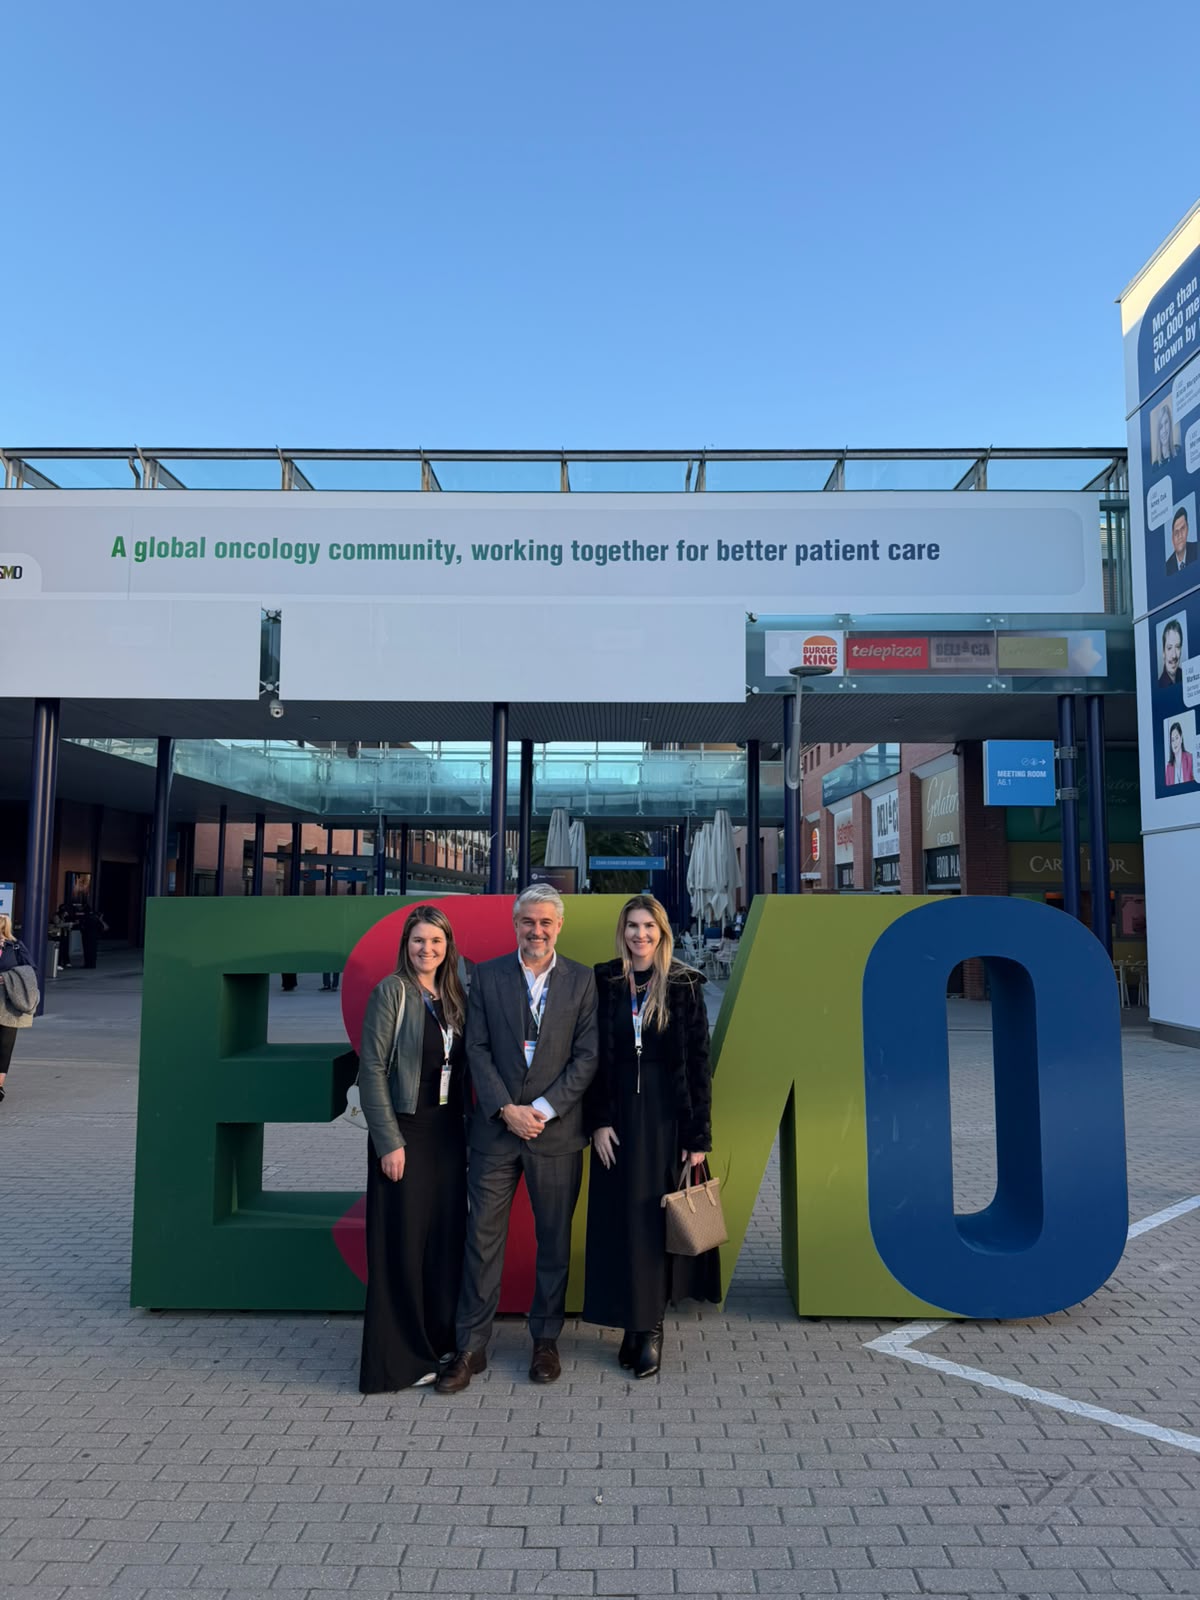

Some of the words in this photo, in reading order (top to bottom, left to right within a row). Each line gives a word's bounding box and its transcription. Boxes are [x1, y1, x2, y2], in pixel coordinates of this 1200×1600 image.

[1152, 301, 1175, 335] More
[1176, 276, 1198, 308] than
[1153, 310, 1184, 354] 50,000
[1185, 297, 1200, 321] me
[1154, 335, 1184, 374] Known
[1185, 321, 1197, 344] by
[110, 535, 127, 558] A
[133, 535, 206, 563] global
[214, 537, 321, 565] oncology
[328, 538, 463, 566] community,
[470, 538, 563, 567] working
[571, 539, 670, 567] together
[676, 539, 710, 562] for
[716, 538, 788, 562] better
[795, 538, 880, 567] patient
[887, 542, 941, 562] care
[803, 647, 838, 655] BURGER
[803, 655, 838, 666] KING
[852, 644, 922, 662] telepizza
[997, 770, 1026, 778] MEETING
[1027, 770, 1047, 778] ROOM
